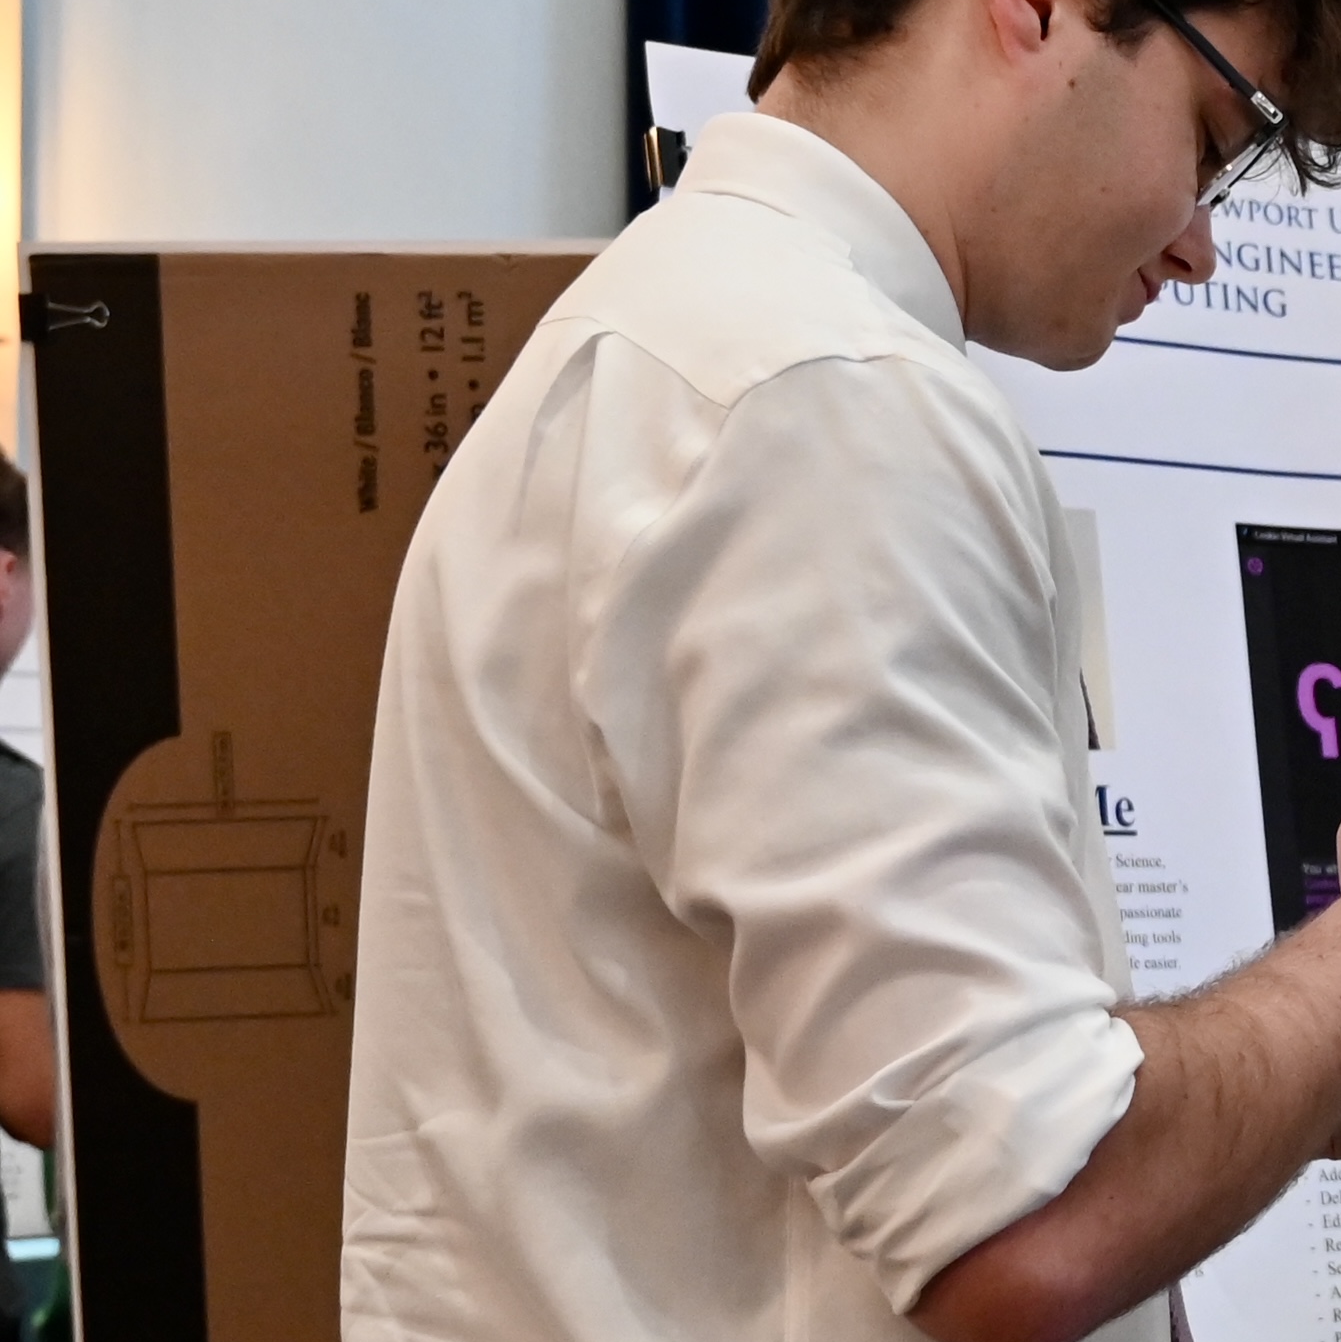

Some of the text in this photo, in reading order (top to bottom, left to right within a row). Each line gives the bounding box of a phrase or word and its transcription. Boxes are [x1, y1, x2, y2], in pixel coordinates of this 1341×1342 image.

[1218, 199, 1319, 231] WPORT
[350, 292, 379, 513] White Blanco Blanc
[1116, 853, 1166, 870] Science,
[1137, 879, 1188, 894] master's
[1120, 906, 1182, 922] passionate
[1152, 930, 1181, 944] tools
